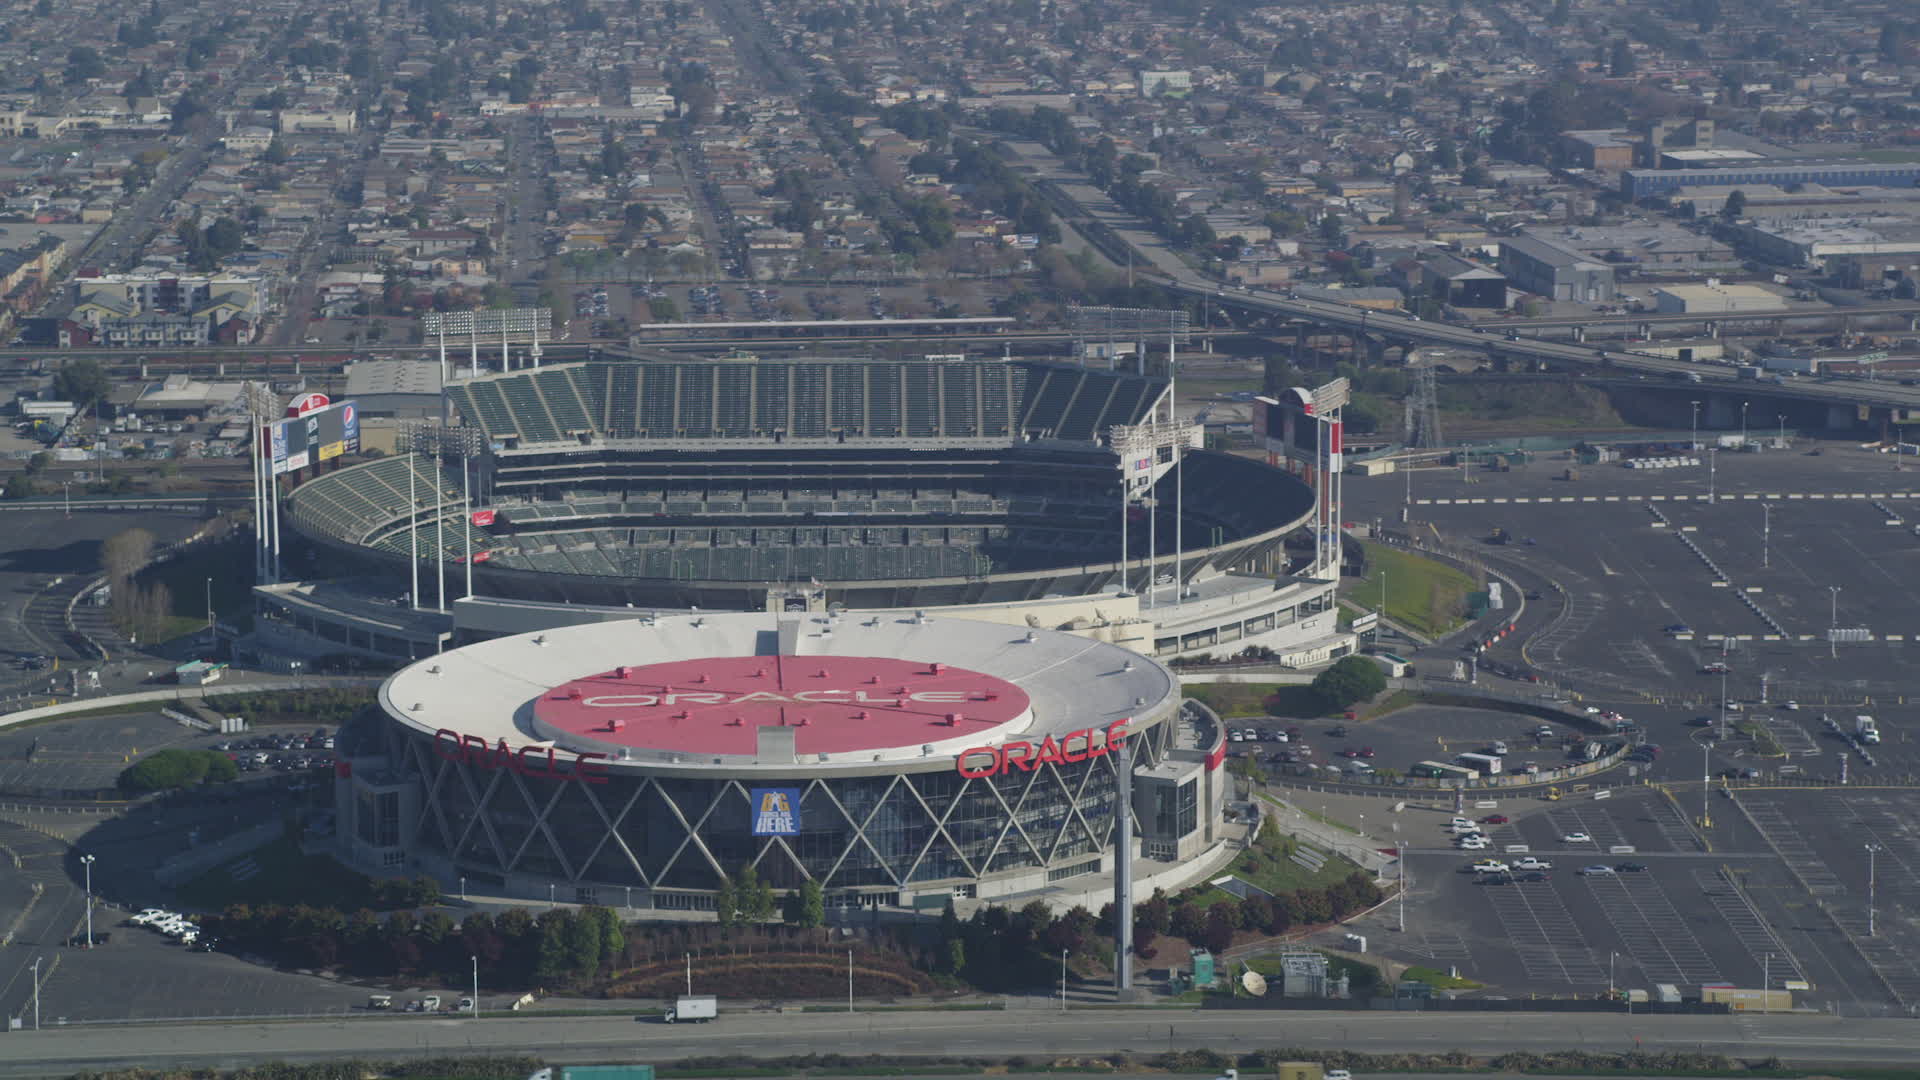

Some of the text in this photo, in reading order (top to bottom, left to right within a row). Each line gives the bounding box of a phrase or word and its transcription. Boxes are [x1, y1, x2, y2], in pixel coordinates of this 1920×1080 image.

[582, 691, 967, 707] ORACLE
[434, 728, 609, 784] ORACLE
[957, 718, 1129, 779] ORACLE
